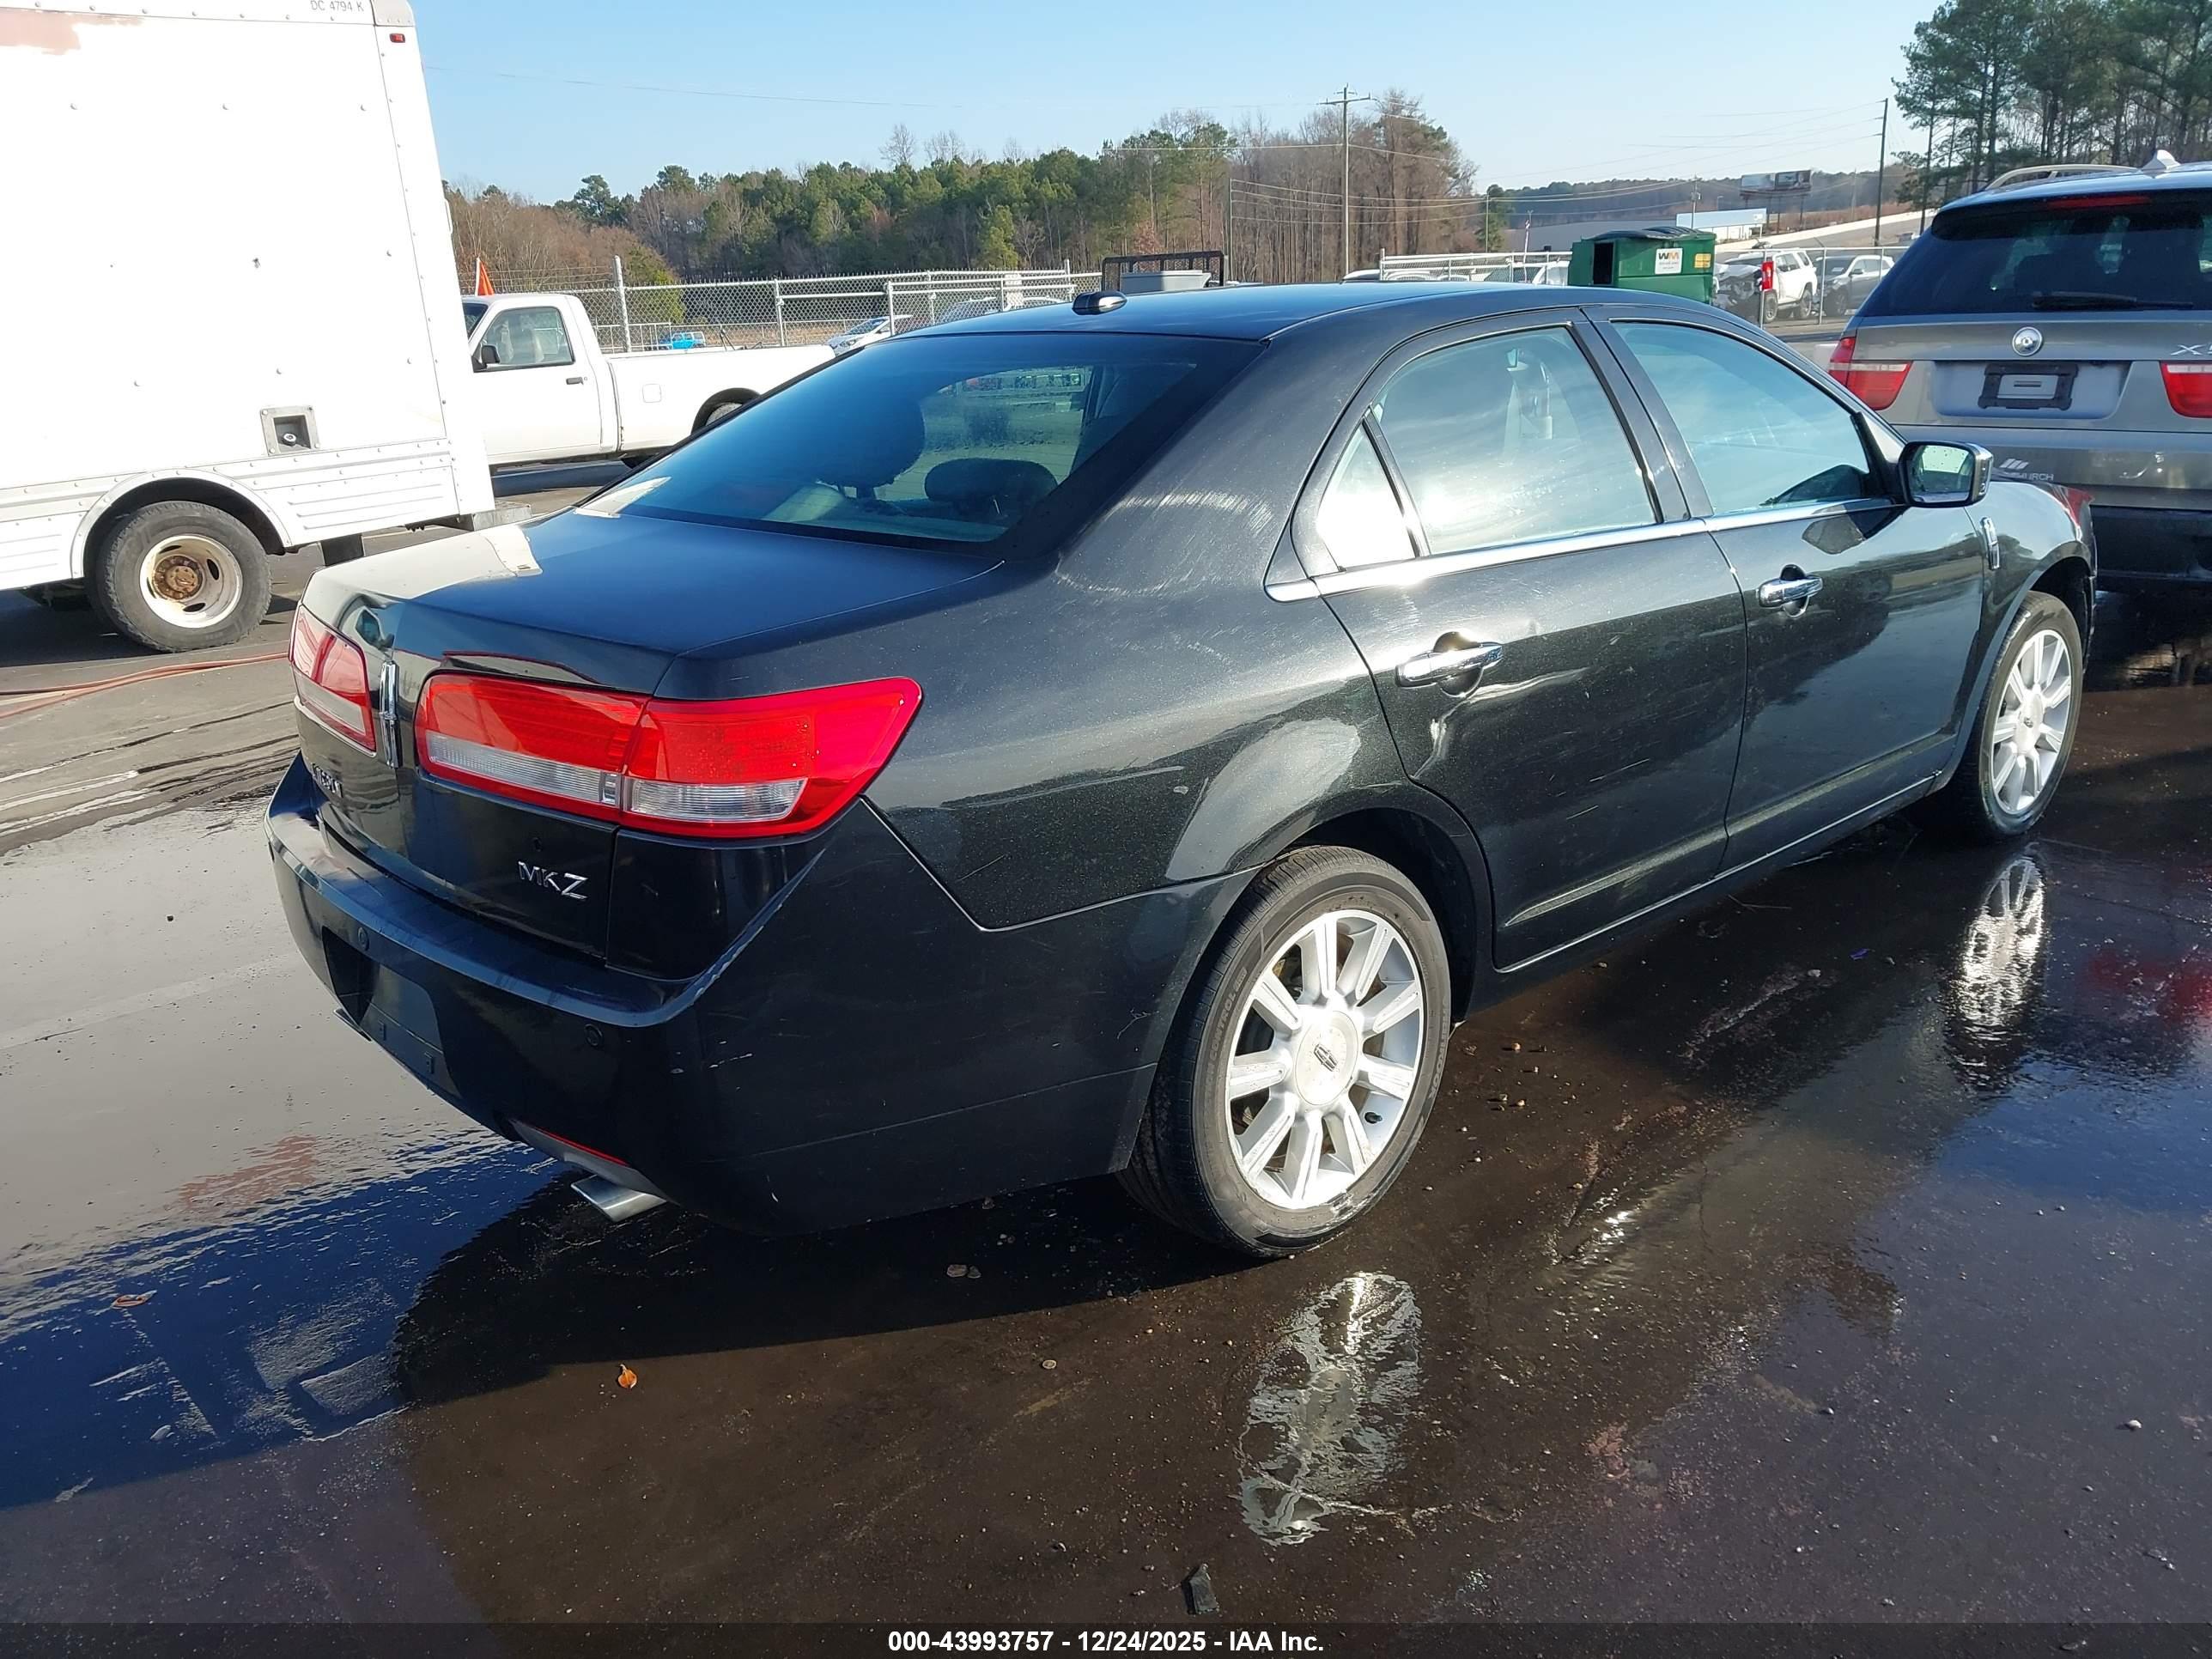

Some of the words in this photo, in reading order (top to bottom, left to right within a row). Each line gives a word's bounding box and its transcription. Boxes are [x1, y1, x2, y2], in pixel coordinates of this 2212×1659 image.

[310, 0, 325, 10] DC
[329, 1, 353, 12] 4794
[356, 2, 364, 12] K
[1658, 252, 1679, 260] WM
[2170, 343, 2212, 356] X
[518, 860, 590, 900] MKZ
[1209, 989, 1237, 1061] CONTROL
